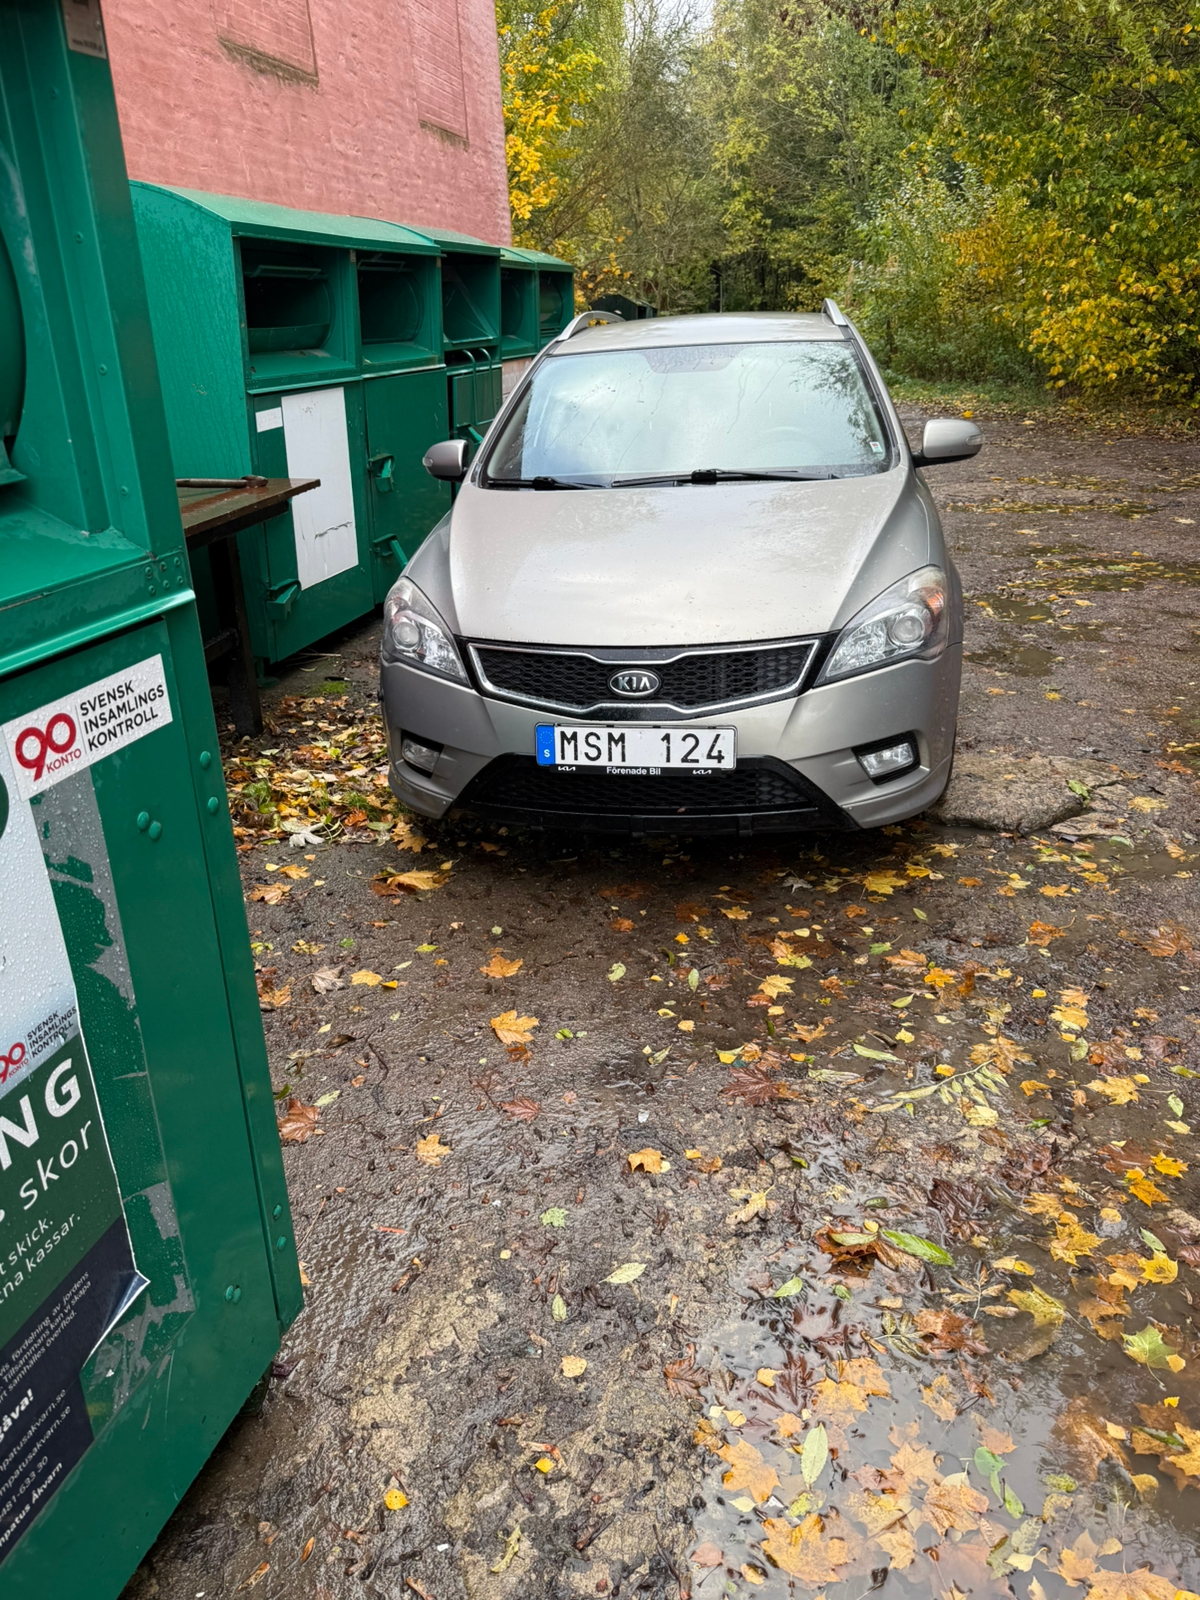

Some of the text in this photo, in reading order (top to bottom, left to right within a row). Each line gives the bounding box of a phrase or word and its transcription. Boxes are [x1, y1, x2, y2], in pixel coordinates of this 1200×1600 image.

[80, 680, 135, 716] SVENSK
[618, 676, 651, 690] KIA
[84, 684, 165, 734] INSAMLINGS
[88, 706, 159, 751] KONTROLL
[15, 712, 77, 782] 90
[46, 748, 82, 773] KONTO
[543, 749, 551, 758] S
[560, 731, 725, 764] MSM 124
[606, 766, 661, 775] Förenade Bil
[27, 1010, 59, 1041] SVENSK
[29, 1006, 77, 1049] INSAMLINGS
[31, 1020, 73, 1059] KONTROLL
[8, 1058, 29, 1078] KONTO
[19, 1119, 92, 1211] skor
[8, 1218, 54, 1267] skick.
[26, 1213, 81, 1273] kassar.
[3, 1281, 91, 1383] Tillsammans kan vi skapa
[12, 1316, 51, 1361] fördelning
[52, 1303, 61, 1316] av
[62, 1271, 89, 1306] jordens
[8, 1346, 46, 1391] samhälles
[46, 1309, 77, 1347] överflöd.
[31, 1462, 63, 1504] Åkvarn
[36, 1455, 48, 1473] 30
